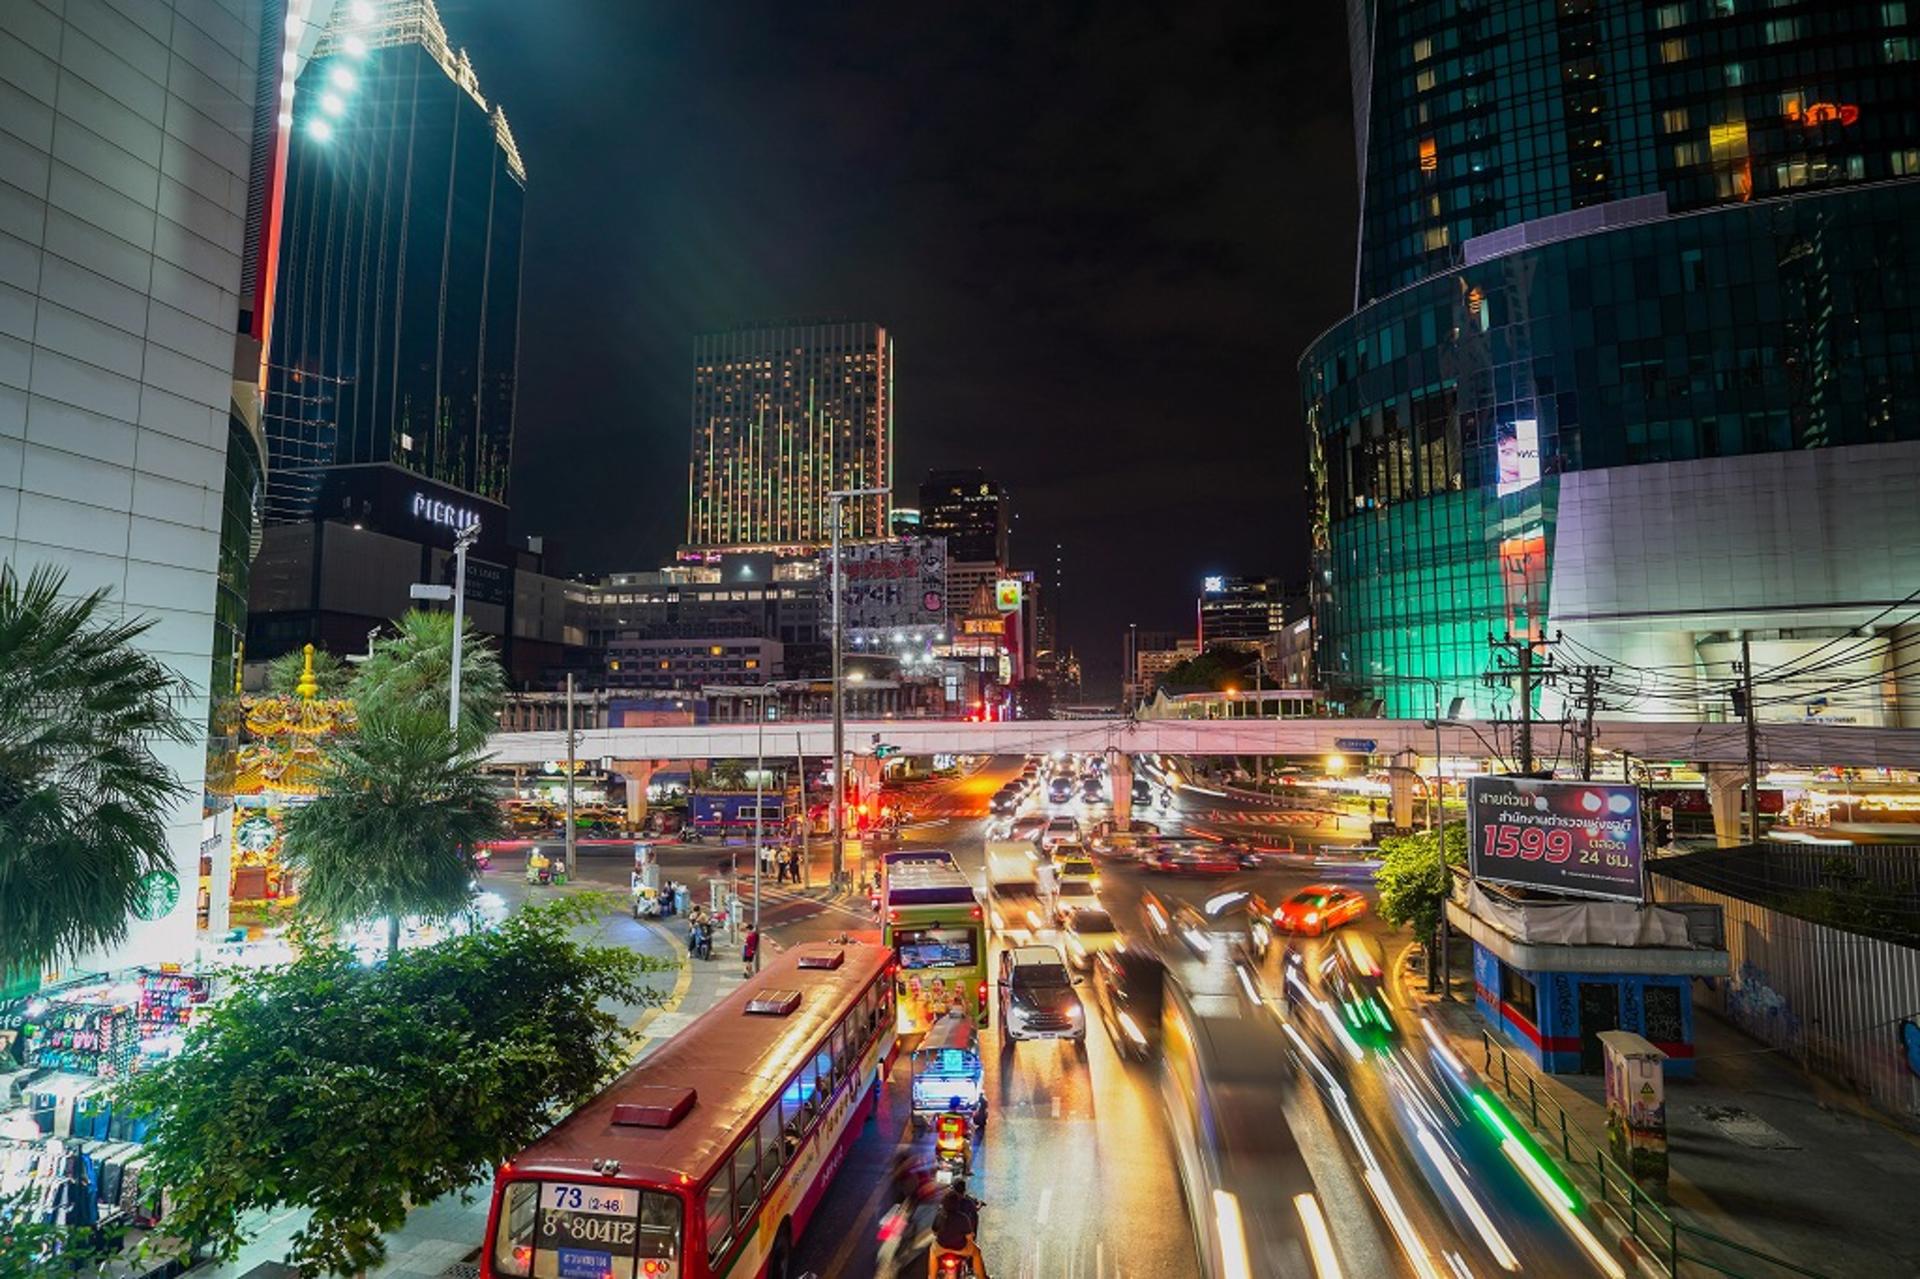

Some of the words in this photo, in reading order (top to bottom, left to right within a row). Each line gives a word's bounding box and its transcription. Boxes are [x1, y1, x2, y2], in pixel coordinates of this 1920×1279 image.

[413, 494, 455, 526] PIER
[1479, 791, 1530, 808] สายด่วน
[1499, 810, 1632, 832] สำนักงานตำรวจแห่งชาติ
[1484, 824, 1573, 864] 1599
[1588, 839, 1627, 851] ตลอด
[1579, 850, 1600, 865] 24
[1606, 853, 1634, 869] ชม.
[554, 1186, 582, 1208] 73
[589, 1197, 623, 1212] (2-46)
